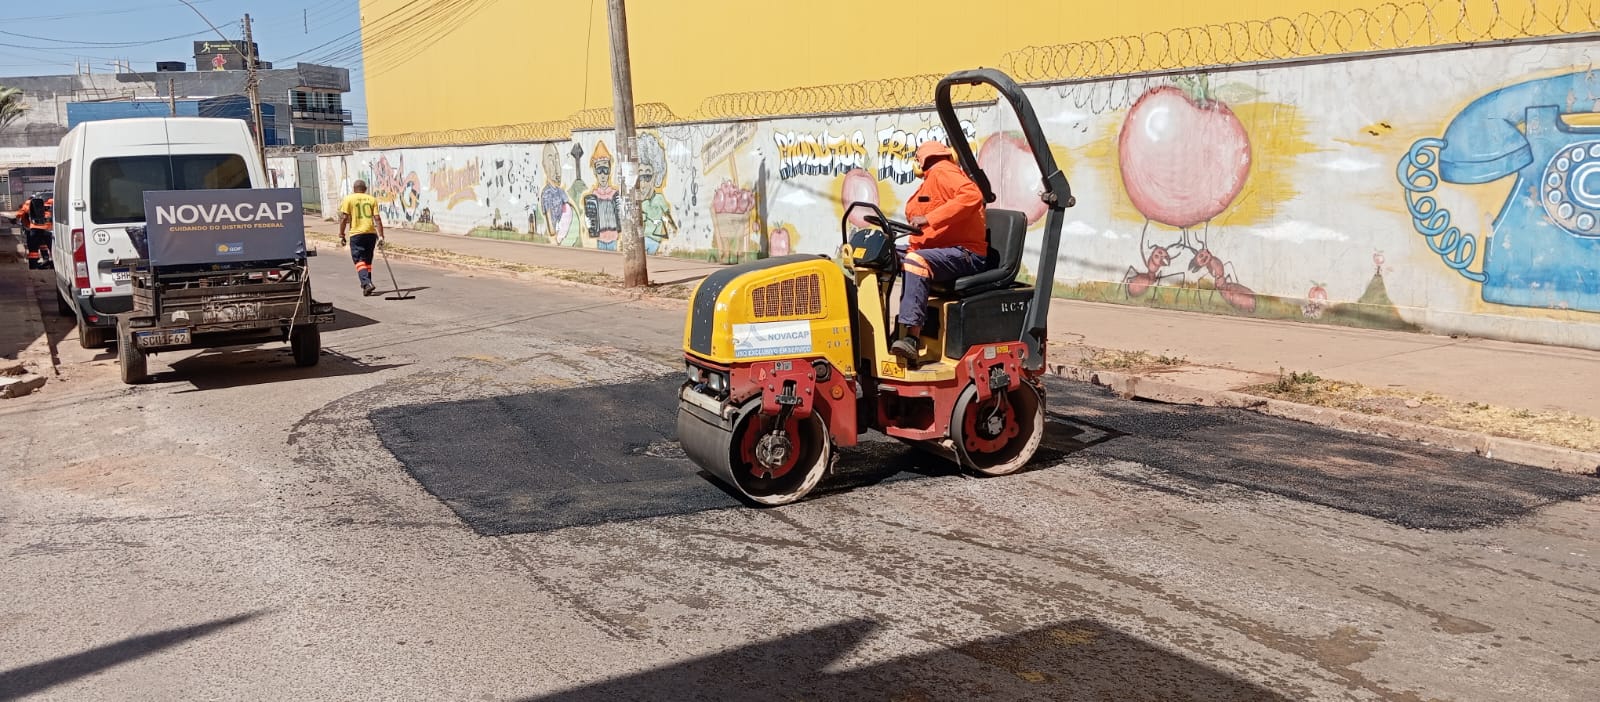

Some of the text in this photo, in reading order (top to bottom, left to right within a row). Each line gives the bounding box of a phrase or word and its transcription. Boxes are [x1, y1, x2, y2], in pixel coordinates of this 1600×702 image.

[155, 202, 294, 225] NOVACAP
[355, 202, 373, 219] 10
[169, 224, 208, 232] CUIDANDO
[222, 223, 252, 231] DISTRITO
[767, 330, 810, 341] NOVACAP
